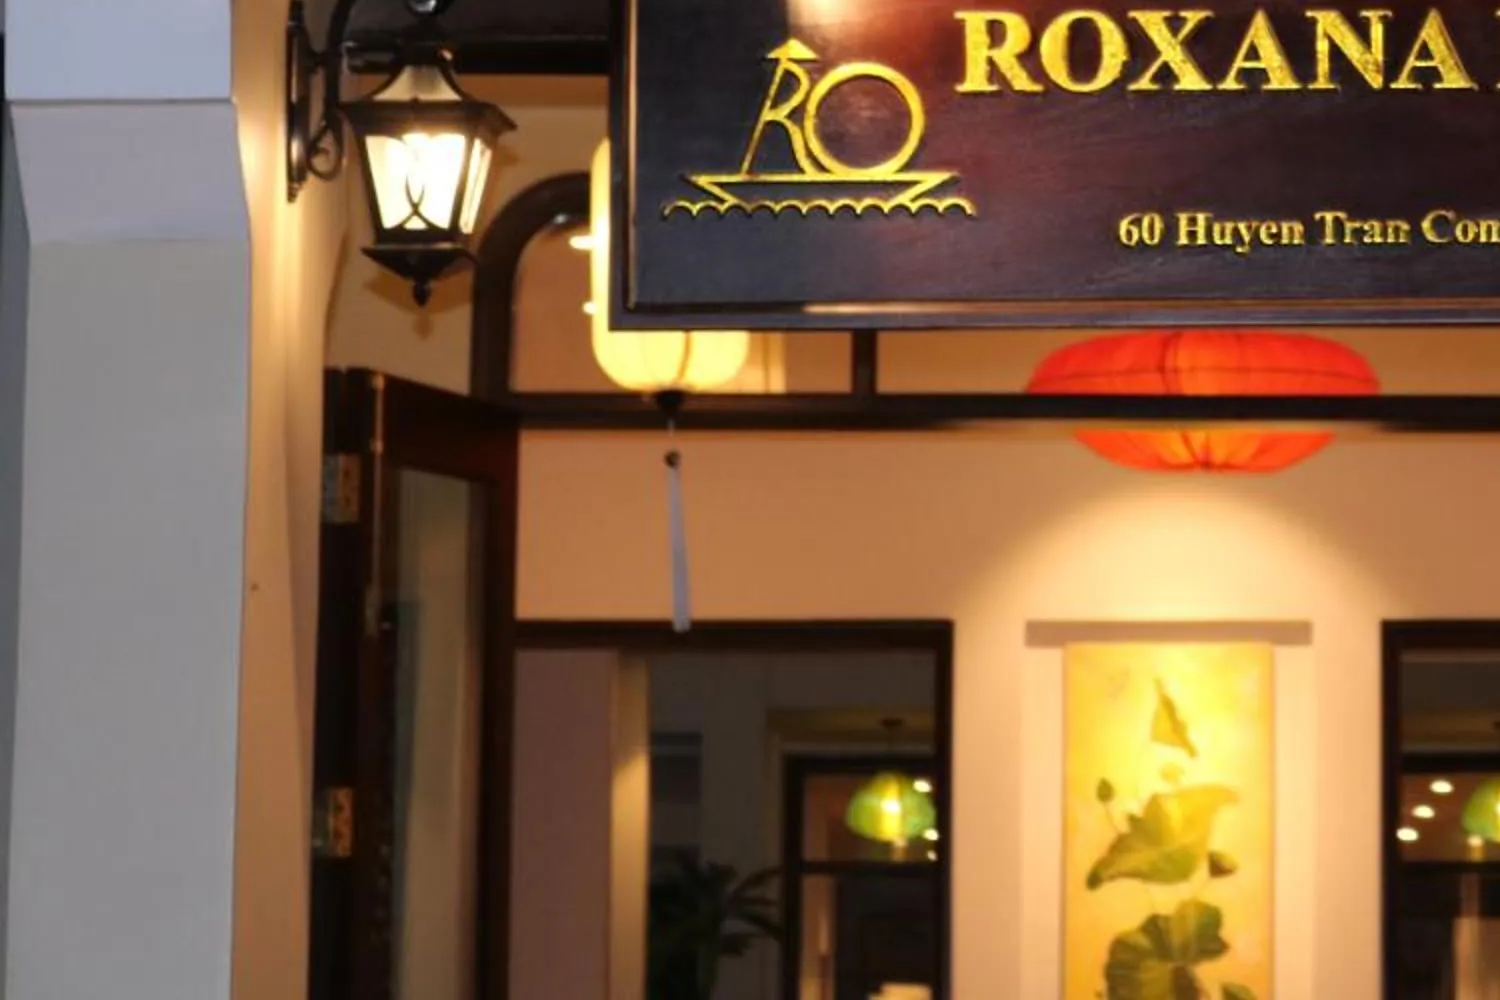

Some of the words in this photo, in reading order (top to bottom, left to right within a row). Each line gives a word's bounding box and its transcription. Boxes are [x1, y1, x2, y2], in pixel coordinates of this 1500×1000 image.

[953, 8, 1478, 94] ROXANA
[1118, 212, 1164, 247] 60
[1175, 211, 1305, 253] Huyen
[1314, 211, 1410, 245] Tran
